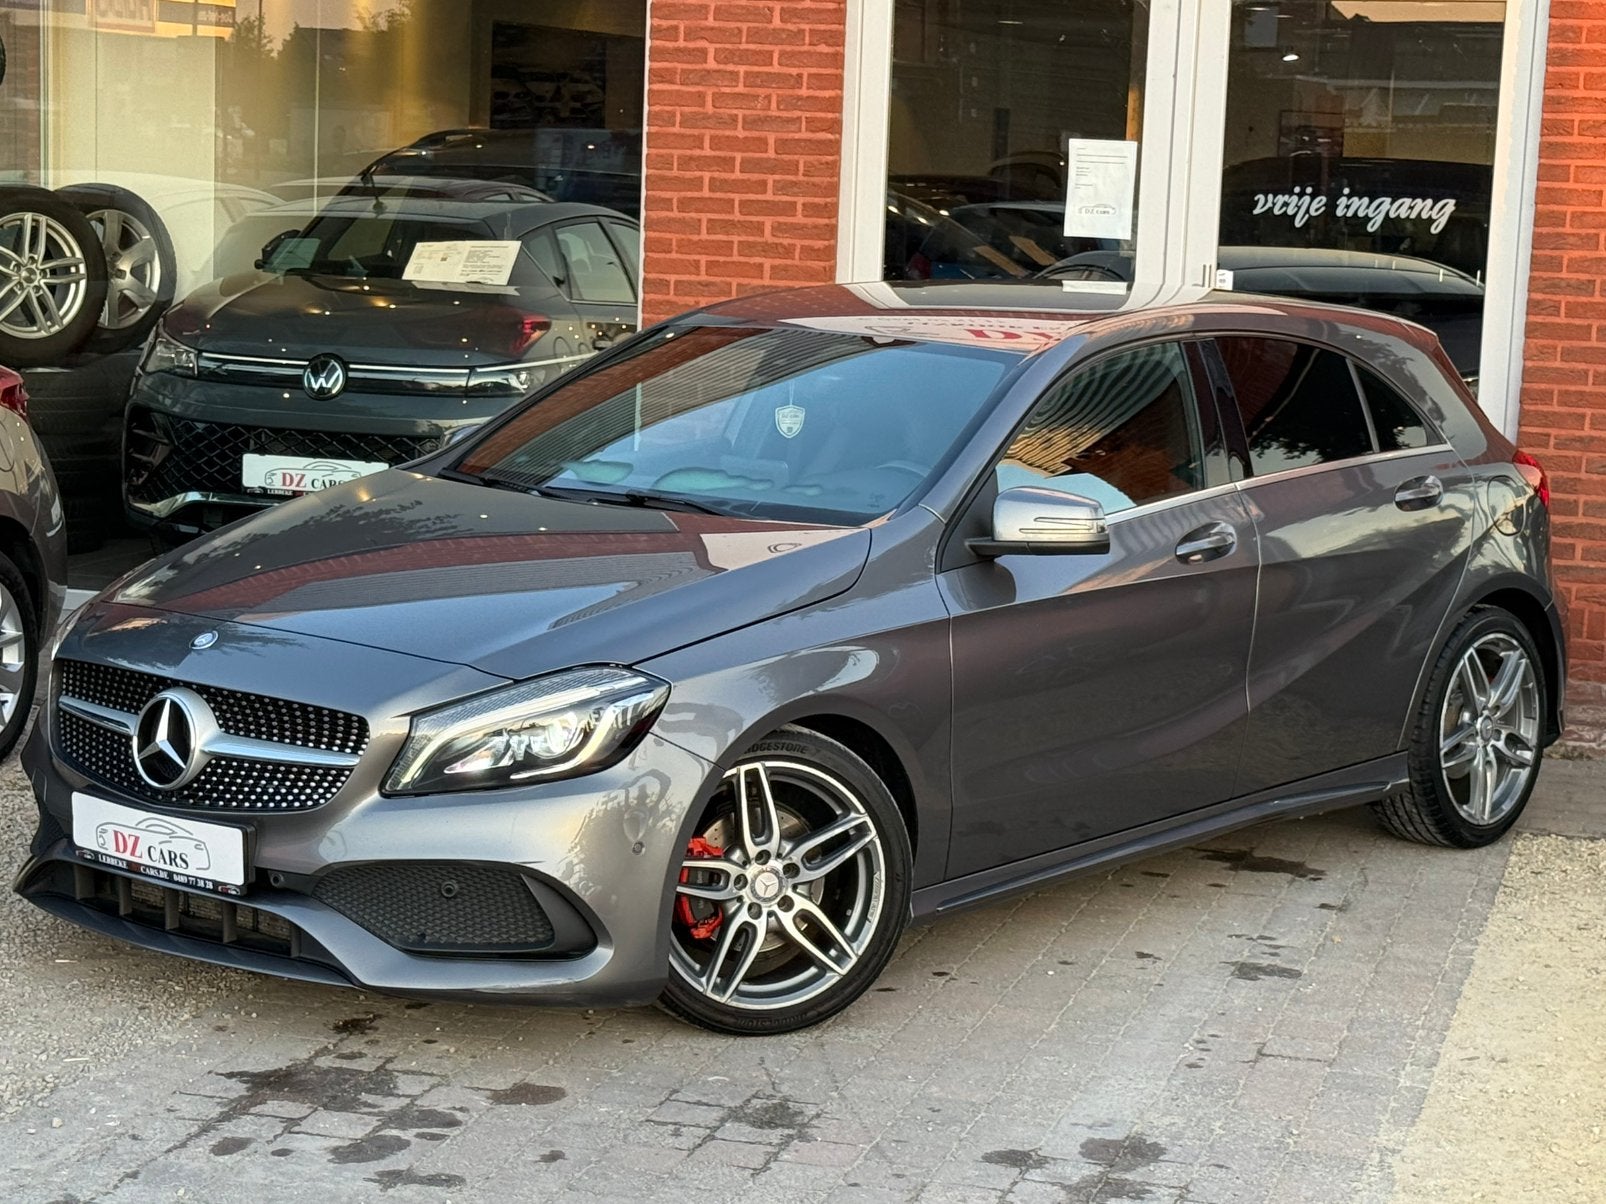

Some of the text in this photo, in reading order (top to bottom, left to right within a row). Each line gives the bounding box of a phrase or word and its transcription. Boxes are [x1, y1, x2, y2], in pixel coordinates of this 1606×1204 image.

[1252, 186, 1456, 234] vrije ingang
[282, 472, 307, 488] DZ
[113, 829, 143, 858] DZ
[147, 845, 189, 870] CARS
